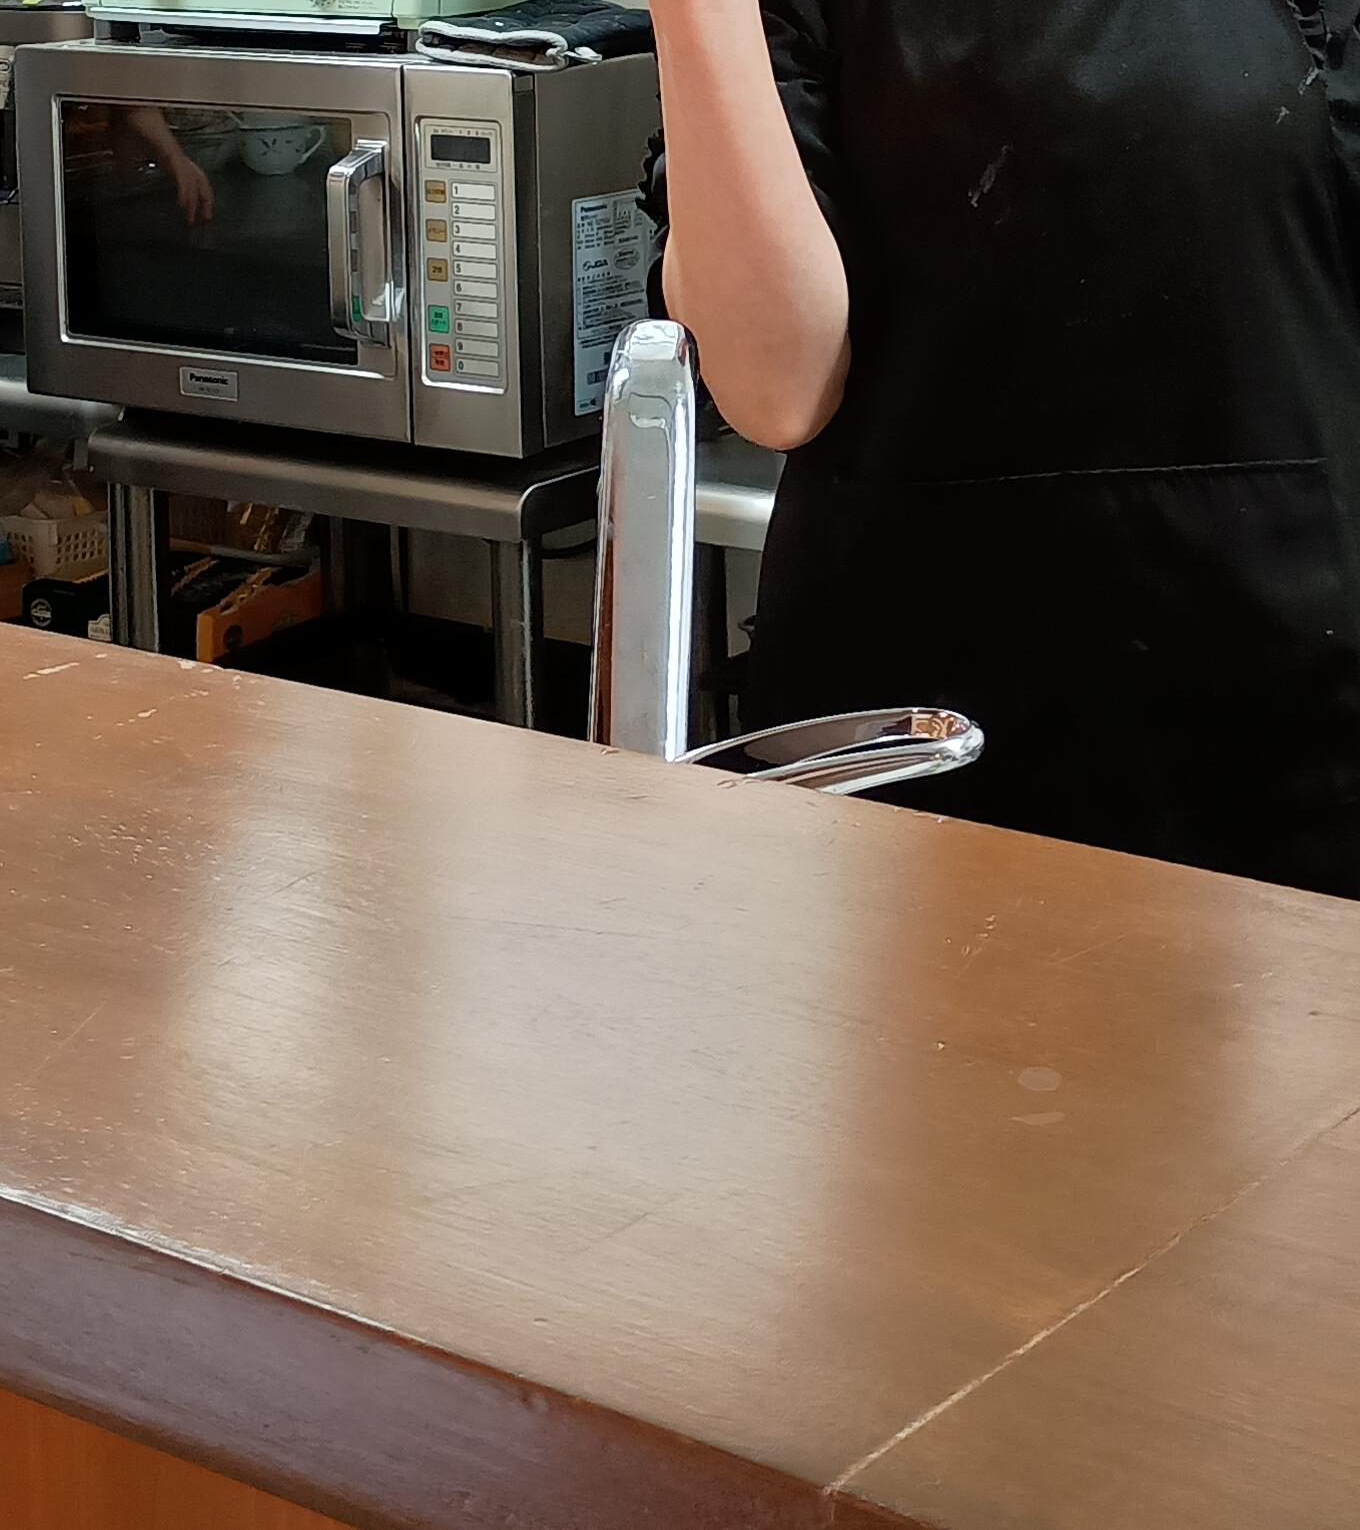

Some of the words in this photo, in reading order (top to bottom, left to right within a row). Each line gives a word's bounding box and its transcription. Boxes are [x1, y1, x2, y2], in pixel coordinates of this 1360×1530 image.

[454, 205, 460, 215] 2
[455, 225, 460, 234] 3
[455, 244, 461, 253] 4
[456, 263, 461, 273] 5
[456, 303, 462, 311] 7
[189, 373, 229, 385] Panasonic
